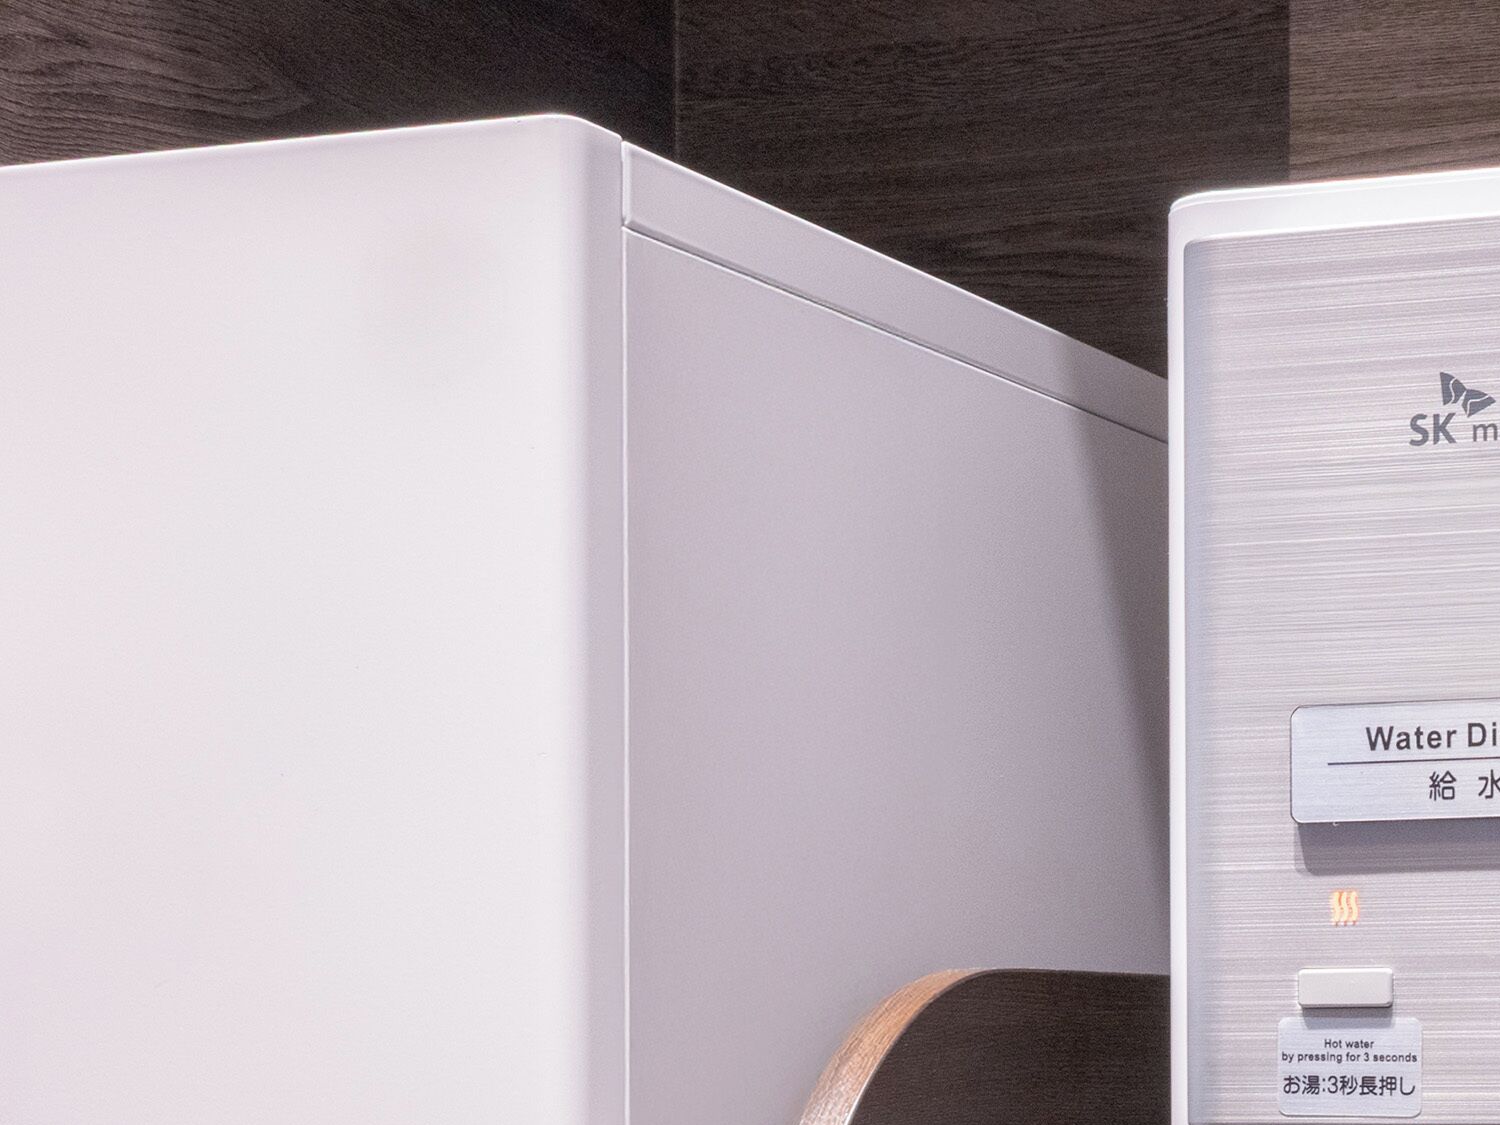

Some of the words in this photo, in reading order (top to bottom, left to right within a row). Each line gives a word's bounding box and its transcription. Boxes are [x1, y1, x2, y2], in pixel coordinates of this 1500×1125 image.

[1409, 412, 1457, 447] SK
[1365, 725, 1458, 752] Water
[1323, 1038, 1342, 1049] Hot
[1345, 1039, 1375, 1049] water
[1281, 1051, 1295, 1064] by
[1297, 1051, 1343, 1064] pressing
[1345, 1051, 1361, 1062] for
[1363, 1052, 1370, 1062] 3
[1373, 1052, 1418, 1063] seconds
